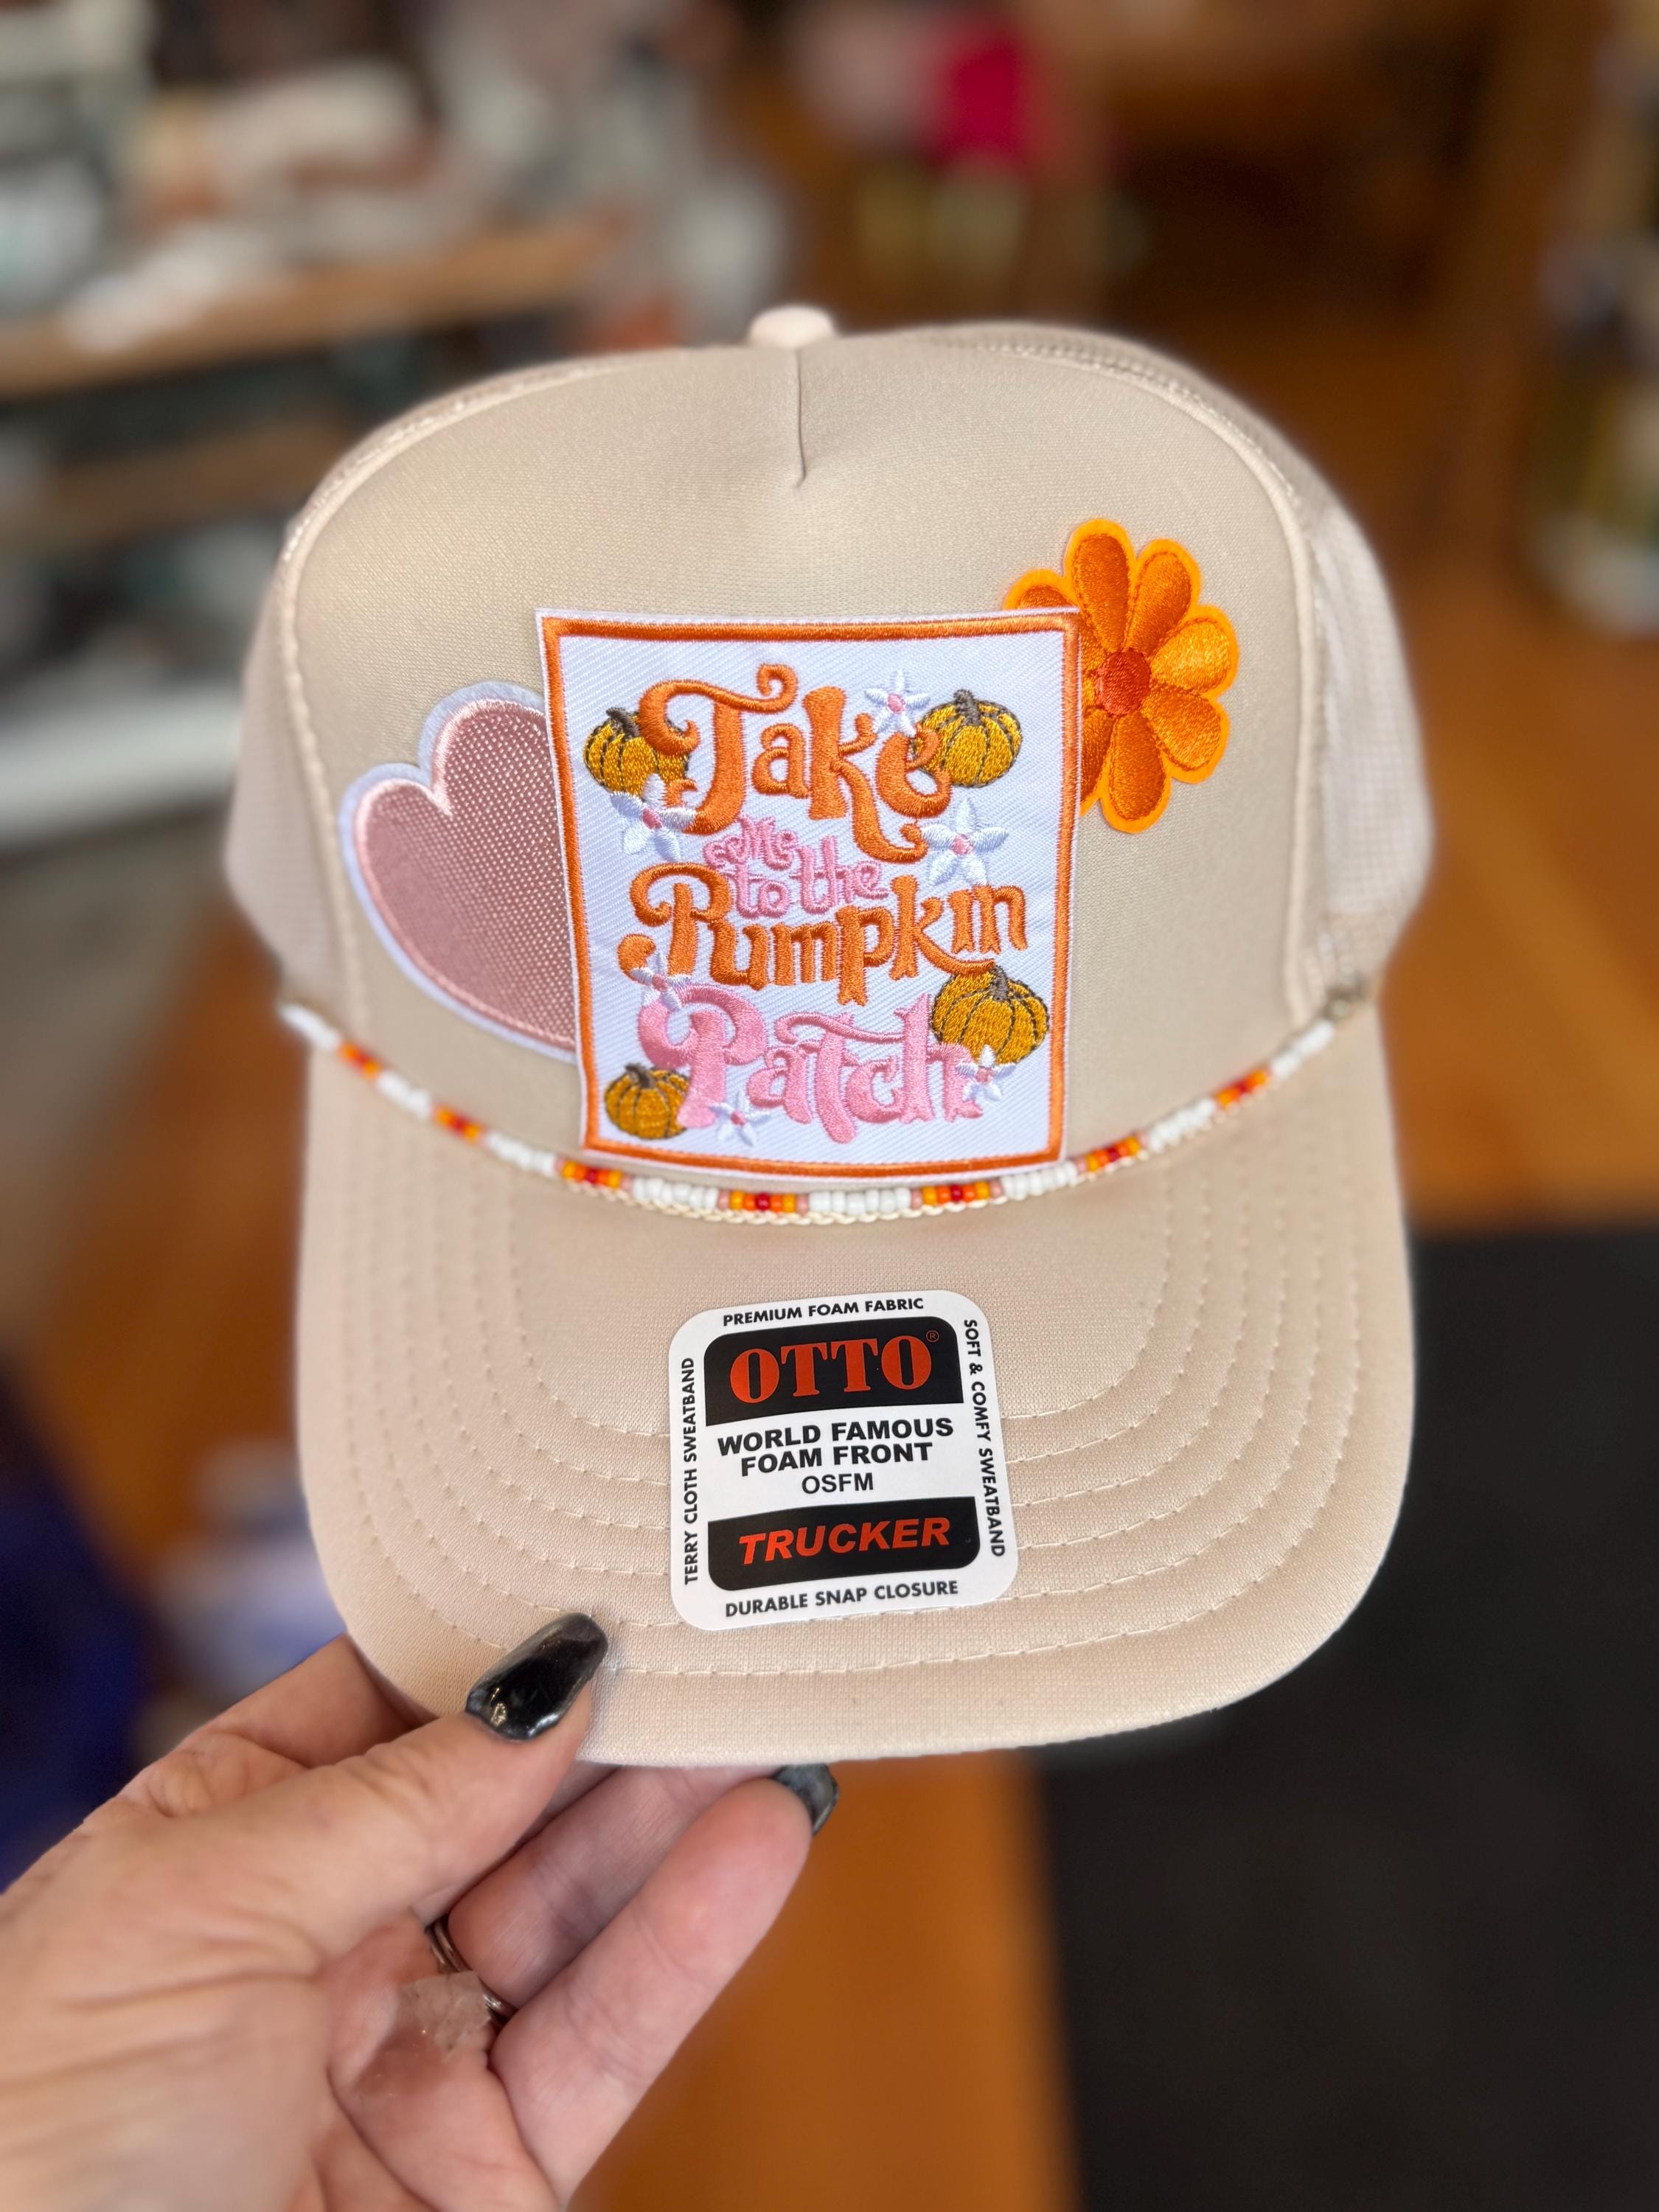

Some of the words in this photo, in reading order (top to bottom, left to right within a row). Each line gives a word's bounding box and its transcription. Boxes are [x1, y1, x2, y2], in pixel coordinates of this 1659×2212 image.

[639, 664, 953, 863] Take
[720, 858, 793, 919] to
[789, 835, 889, 915] the
[617, 863, 1029, 1006] Pumpkin
[638, 983, 983, 1144] Patch
[723, 1307, 802, 1326] PREMIUM
[808, 1301, 859, 1317] FOAM
[865, 1298, 924, 1312] FABRIC
[964, 1319, 981, 1357] SOFT
[969, 1363, 983, 1375] &
[681, 1357, 697, 1463] SWEATBAND
[717, 1425, 821, 1456] WORLD
[831, 1417, 953, 1441] FAMOUS
[971, 1381, 991, 1442] COMFY
[741, 1447, 822, 1477] FOAM
[833, 1442, 933, 1465] FRONT
[801, 1472, 874, 1495] OSFM
[684, 1468, 698, 1524] CLOTH
[978, 1447, 1006, 1557] SWEATBAND
[684, 1531, 698, 1585] TERRY
[739, 1517, 950, 1565] TRUCKER
[725, 1593, 808, 1618] DURABLE
[815, 1587, 867, 1606] SNAP
[874, 1580, 959, 1601] CLOSURE
